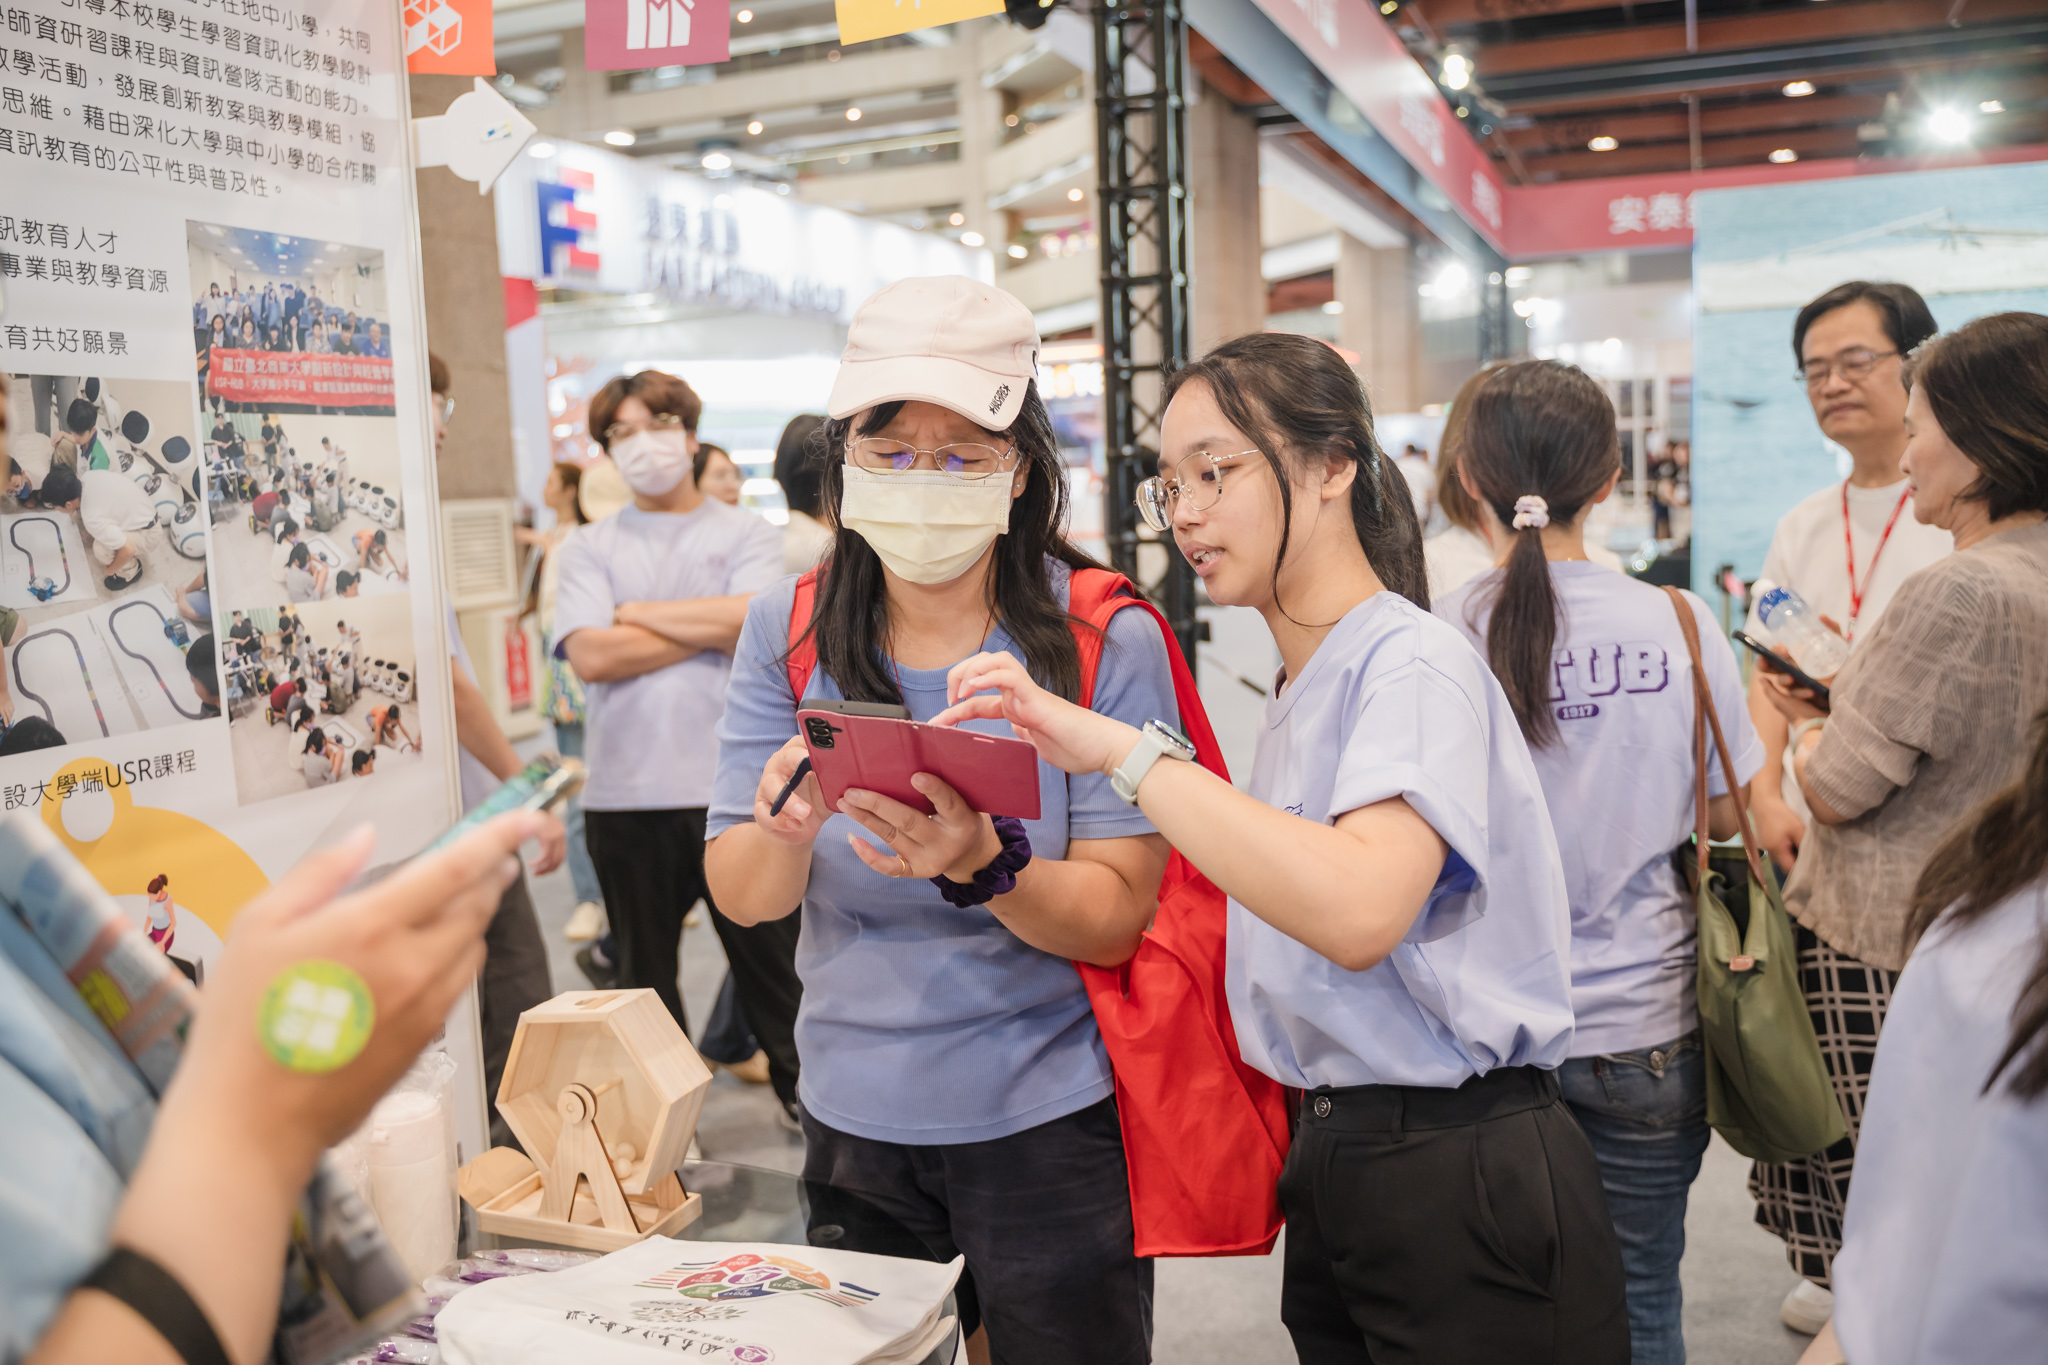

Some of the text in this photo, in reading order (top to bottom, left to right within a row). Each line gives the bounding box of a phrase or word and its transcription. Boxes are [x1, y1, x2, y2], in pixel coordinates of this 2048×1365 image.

[0, 6, 369, 116] 師資研習課程與資訊營隊活動的能力。
[0, 324, 128, 356] 育共好願景
[1562, 705, 1595, 719] 1917
